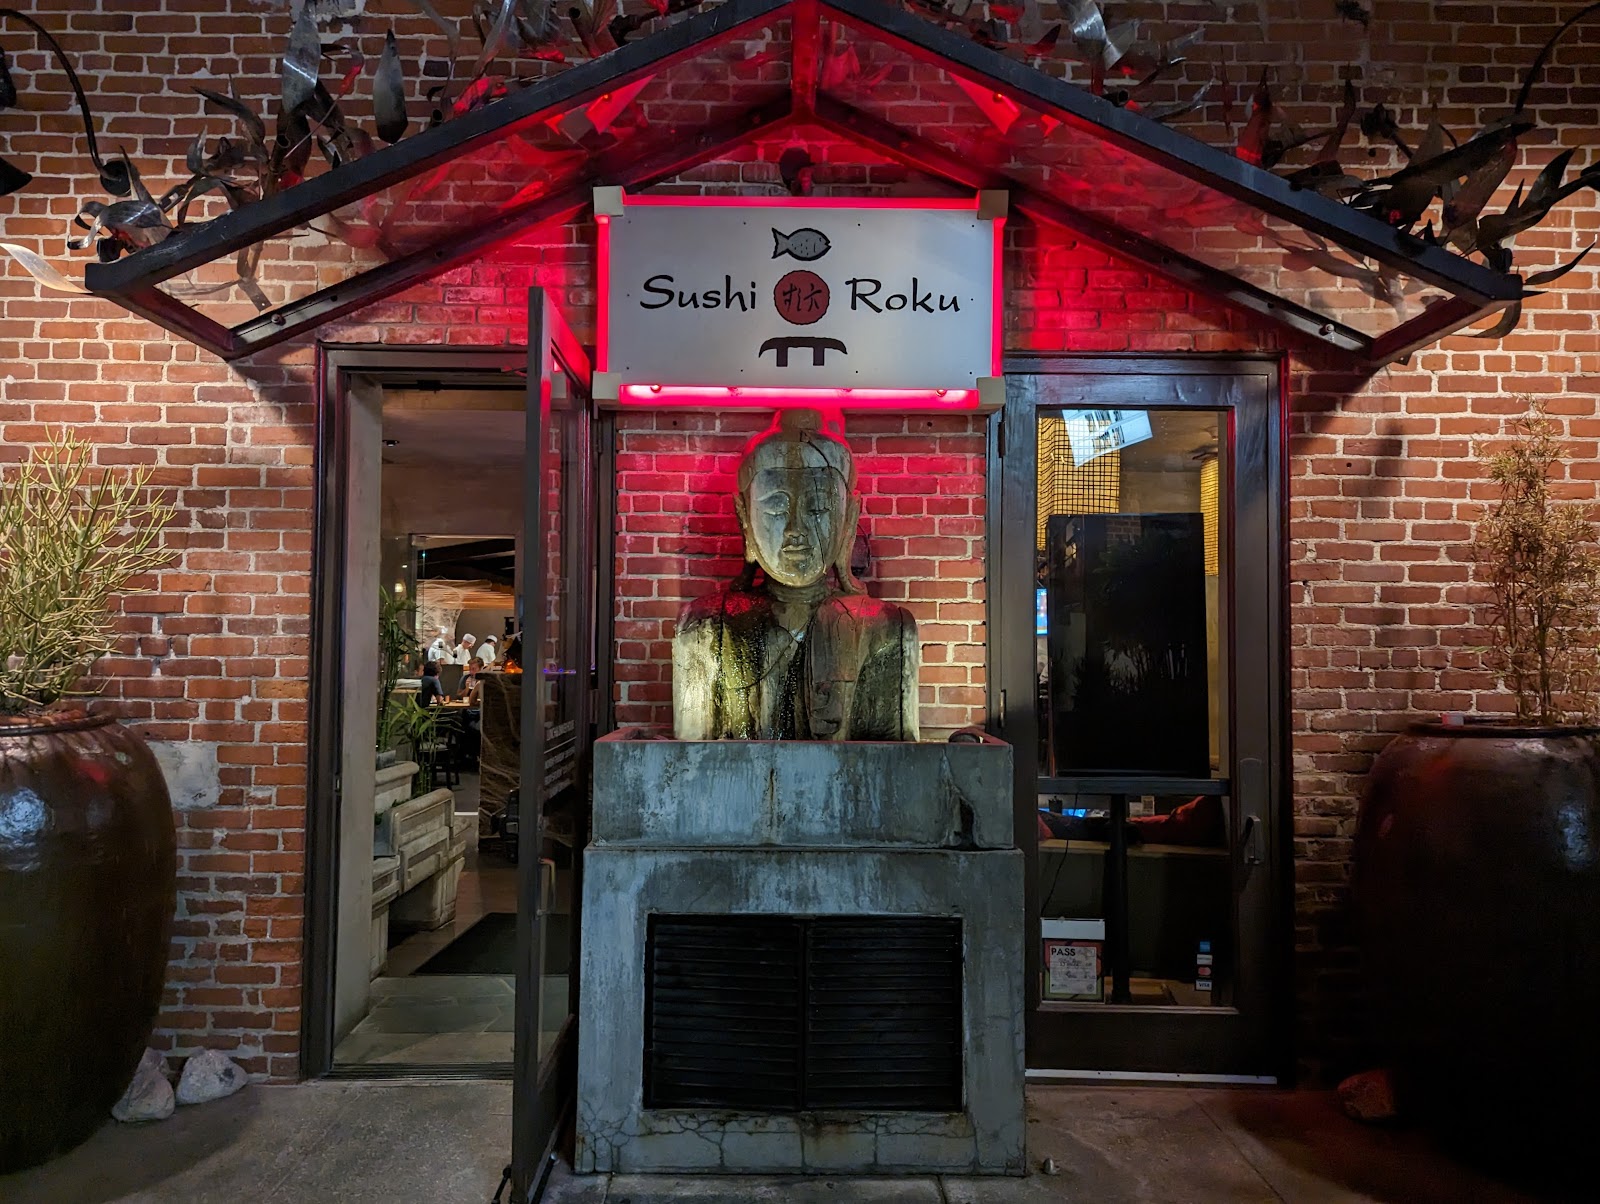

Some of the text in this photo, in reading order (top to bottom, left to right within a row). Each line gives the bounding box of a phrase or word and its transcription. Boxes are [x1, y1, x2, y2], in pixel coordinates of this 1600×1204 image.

[639, 274, 961, 314] Sushi Roku
[1051, 947, 1076, 957] PASS
